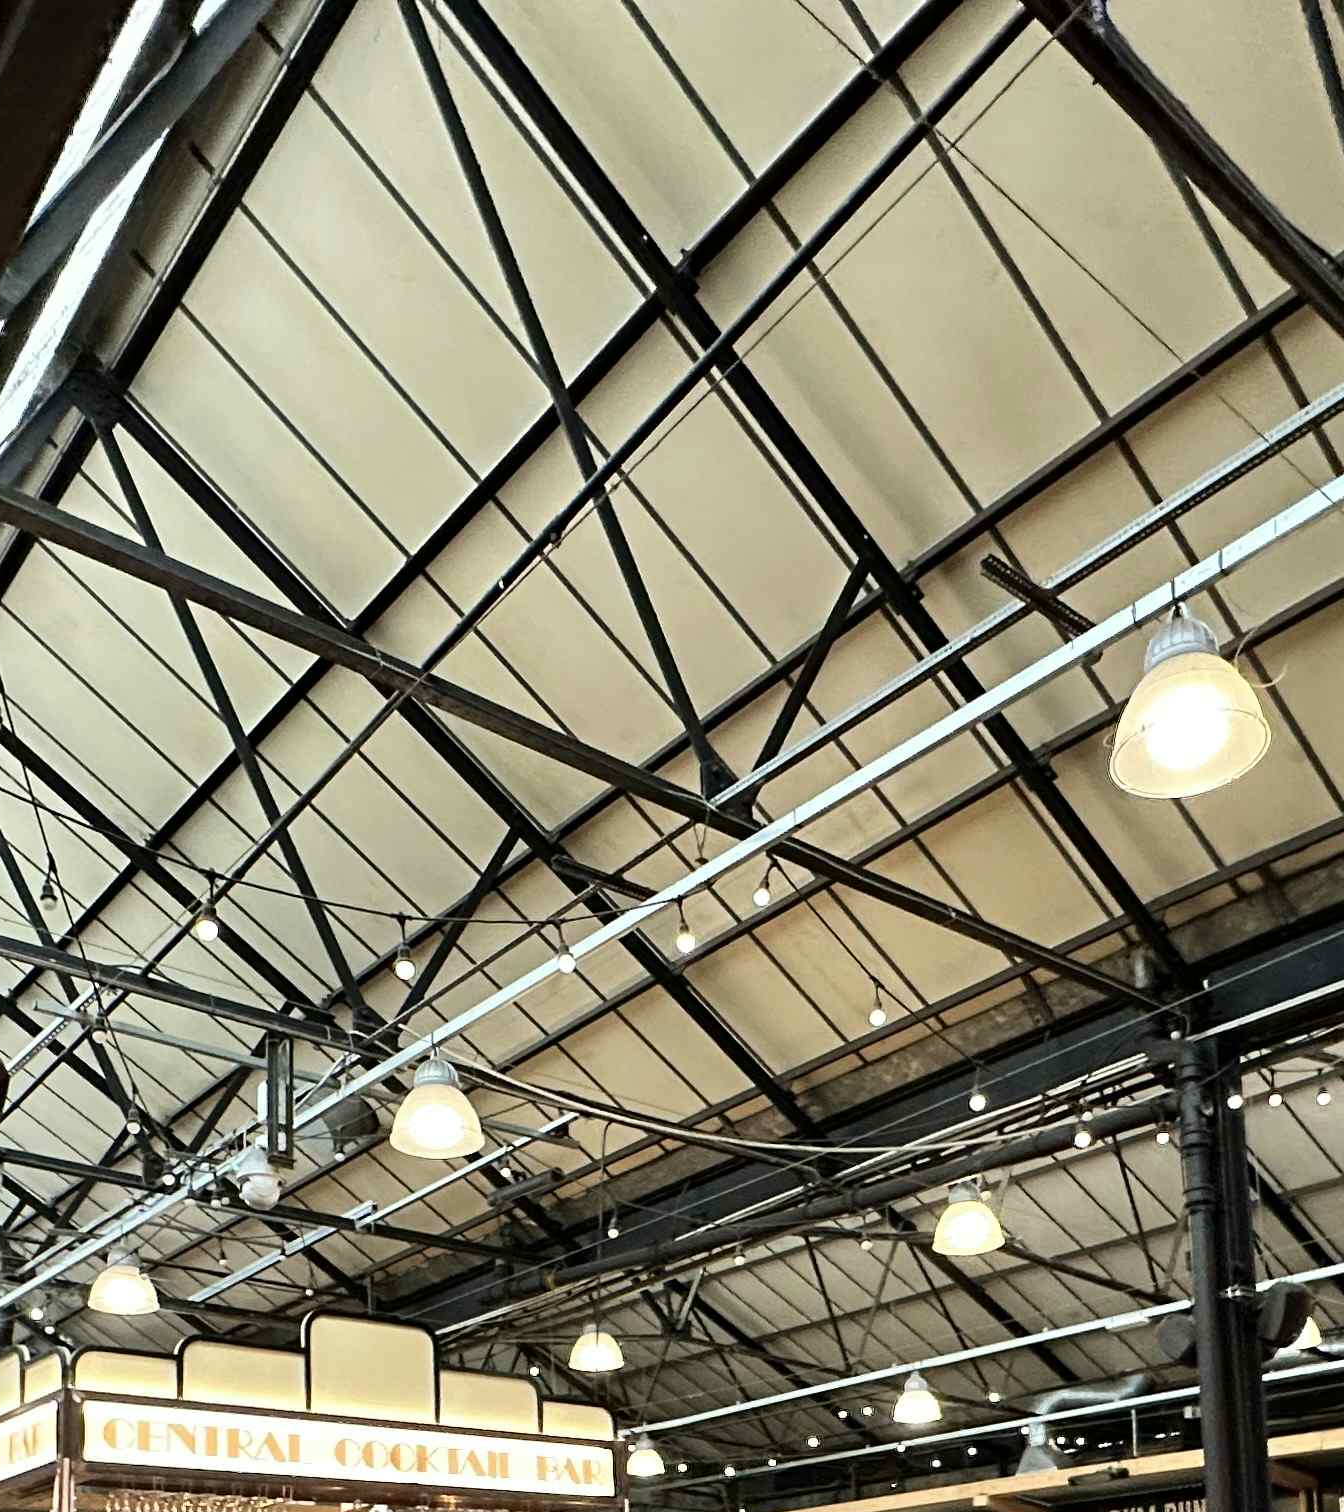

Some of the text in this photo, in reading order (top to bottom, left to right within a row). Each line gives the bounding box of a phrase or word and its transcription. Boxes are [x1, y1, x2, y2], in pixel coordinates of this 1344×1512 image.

[103, 1418, 606, 1485] CENTRAL COCKTAIL BAR
